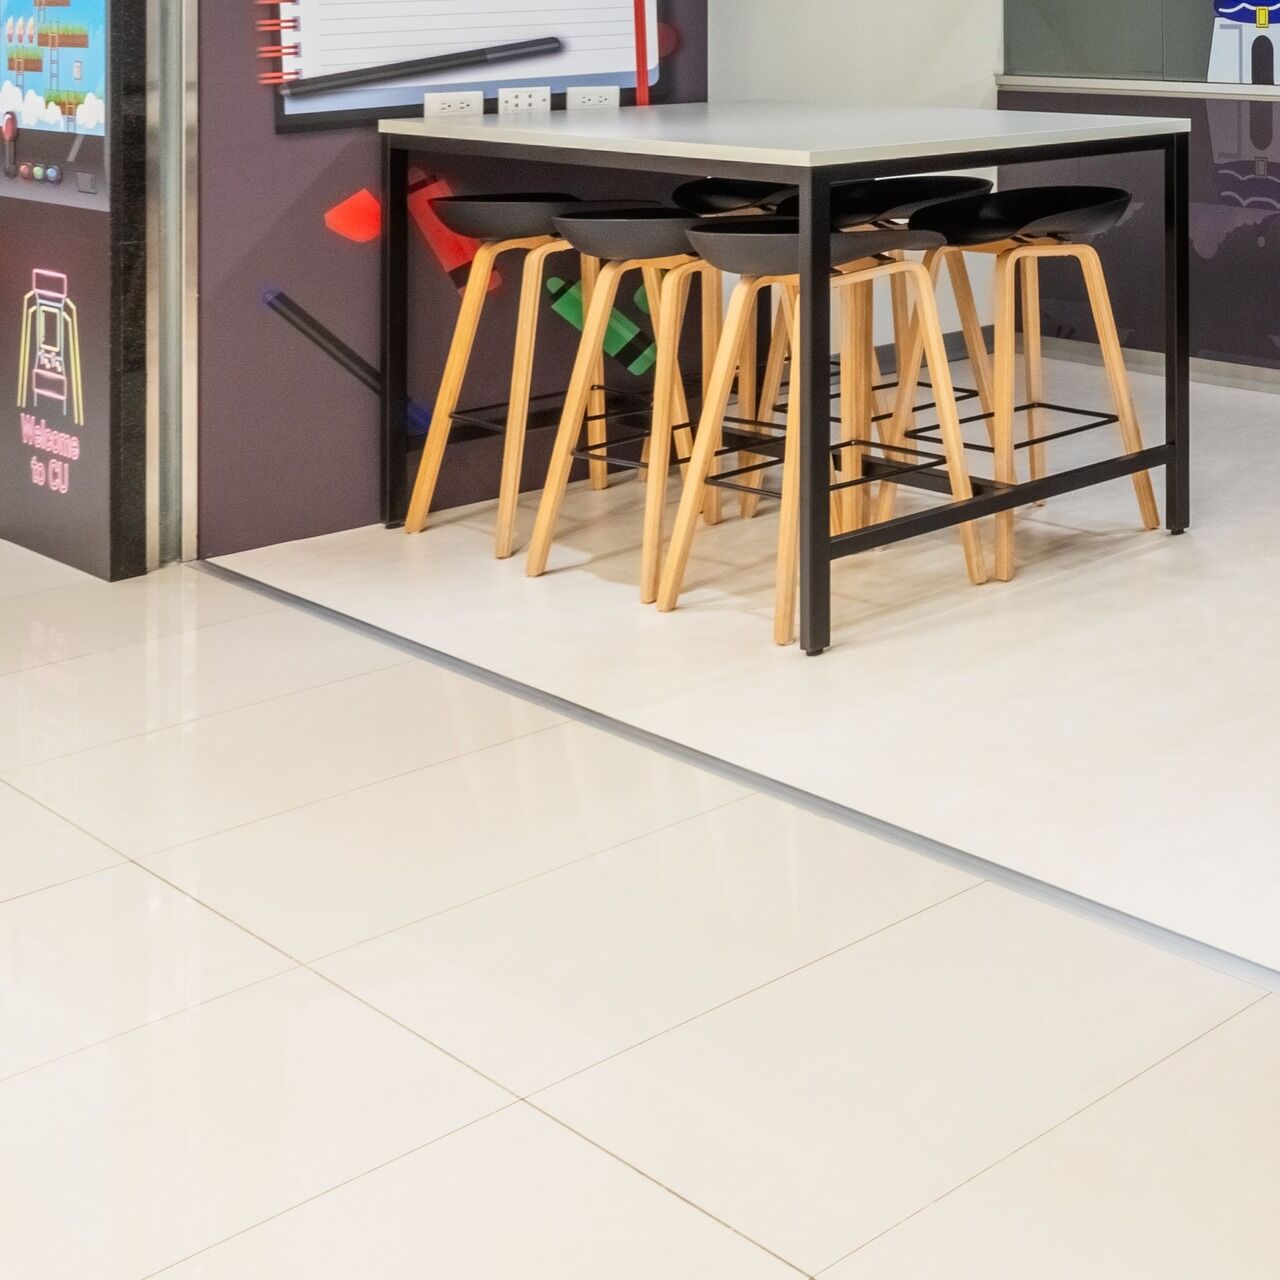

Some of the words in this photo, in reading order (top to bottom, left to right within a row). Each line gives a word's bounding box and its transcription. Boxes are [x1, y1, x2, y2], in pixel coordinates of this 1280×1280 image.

[20, 412, 81, 461] Welcome
[30, 456, 46, 486] to
[48, 458, 70, 494] CU
